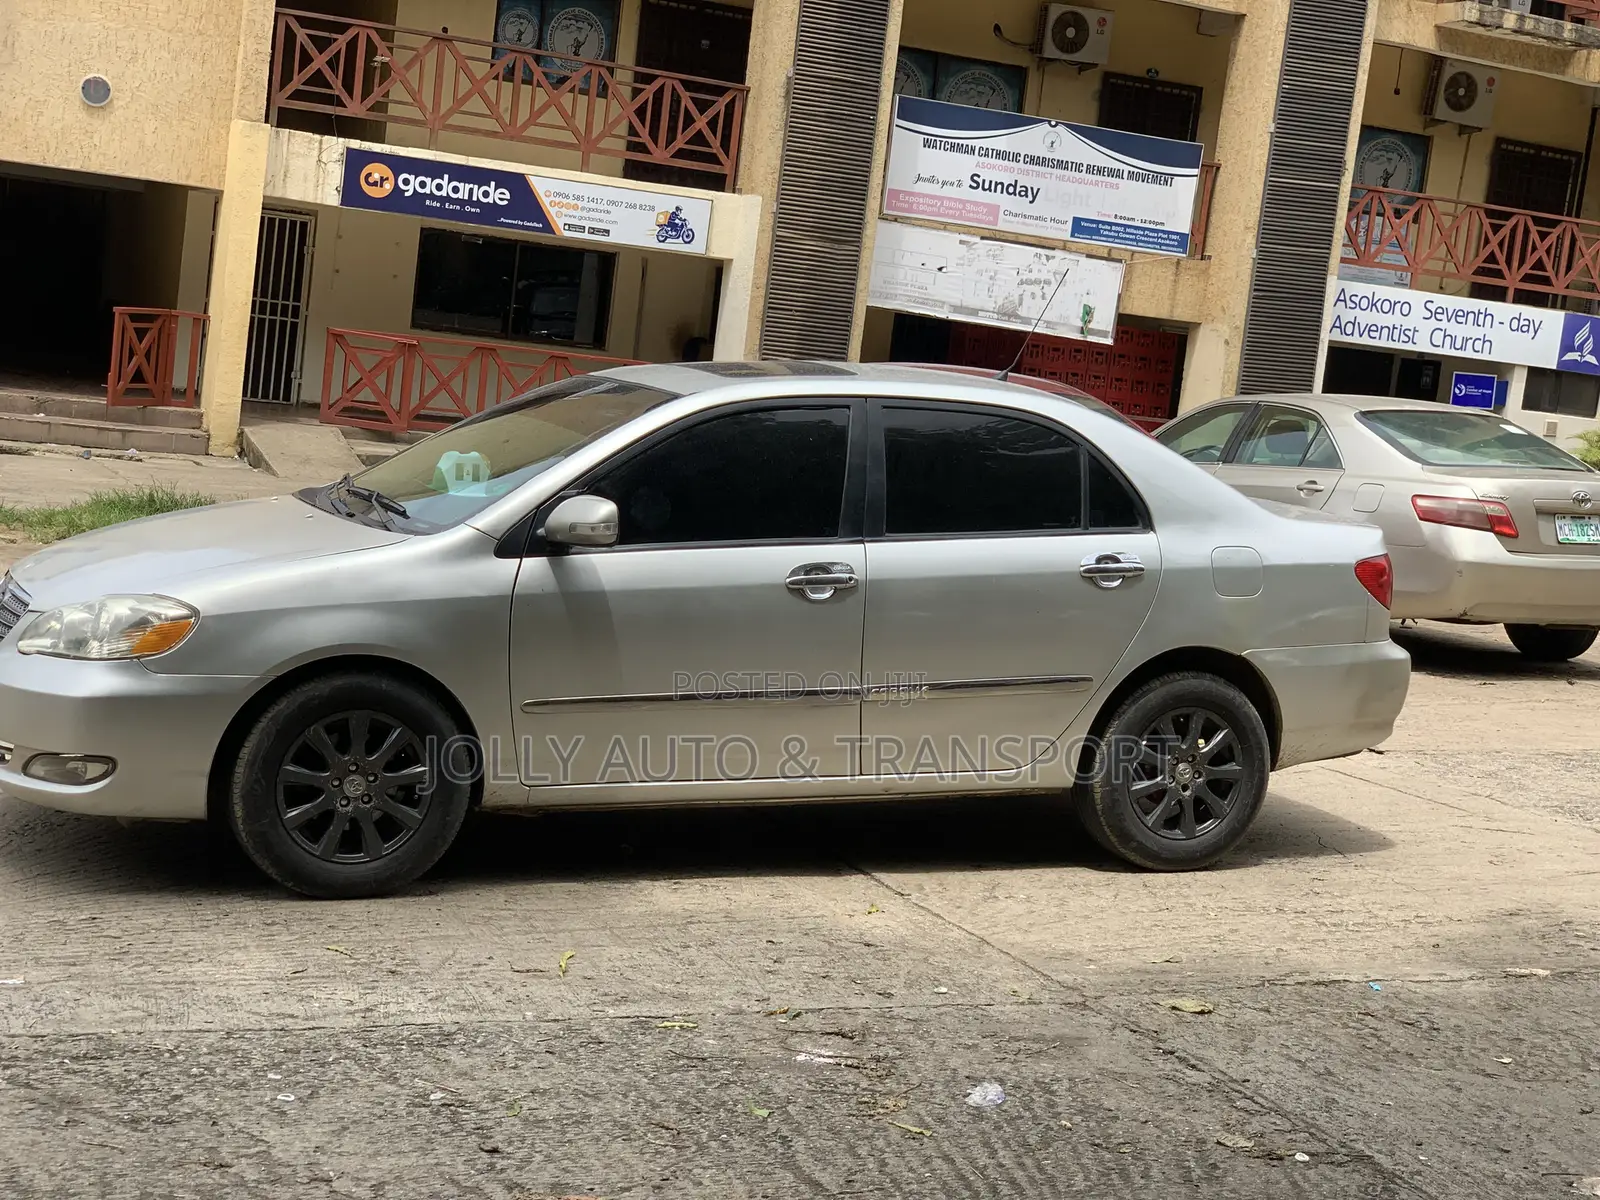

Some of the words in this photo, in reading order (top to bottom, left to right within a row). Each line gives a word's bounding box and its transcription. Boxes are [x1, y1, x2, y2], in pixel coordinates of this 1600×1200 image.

[1096, 28, 1105, 36] LG
[922, 136, 977, 157] WATCHMAN
[977, 146, 1022, 164] CATHOLIC
[1022, 153, 1085, 174] CHARISMATIC
[1085, 162, 1125, 181] RENEWAL
[1126, 169, 1175, 188] MOVEMENT
[912, 172, 940, 187] Invites
[940, 177, 955, 190] you
[955, 177, 964, 188] to
[975, 160, 1016, 175] ASOKORO
[1016, 167, 1054, 181] DISTRICT
[1054, 172, 1120, 191] HEADQUARTERS
[397, 172, 512, 207] gadaride
[968, 172, 1041, 205] Sunday
[425, 199, 441, 208] Ride
[445, 202, 461, 211] Earn
[465, 205, 481, 213] Own
[552, 190, 571, 201] 0906
[571, 193, 585, 203] 585
[586, 195, 605, 207] 1417,
[606, 199, 624, 209] 0907
[624, 202, 638, 211] 268
[638, 204, 656, 213] 8238
[580, 205, 612, 216] @gadaride
[899, 193, 943, 207] Expository
[943, 198, 963, 210] Bible
[965, 202, 988, 214] Study
[563, 212, 619, 226] www.gadaride.com
[940, 206, 960, 217] Every
[961, 208, 994, 223] Tuesdays
[1003, 208, 1048, 223] Charismatic
[1049, 215, 1069, 226] Hour
[1113, 213, 1136, 223] 8:00am
[1139, 217, 1166, 228] 12:00pm
[1098, 222, 1111, 231] Suite
[1144, 230, 1159, 238] Plaza
[1333, 287, 1412, 318] Asokoro
[1422, 299, 1495, 329] Seventh
[1508, 311, 1544, 341] day
[1329, 314, 1420, 346] Adventist
[1429, 327, 1494, 356] Church
